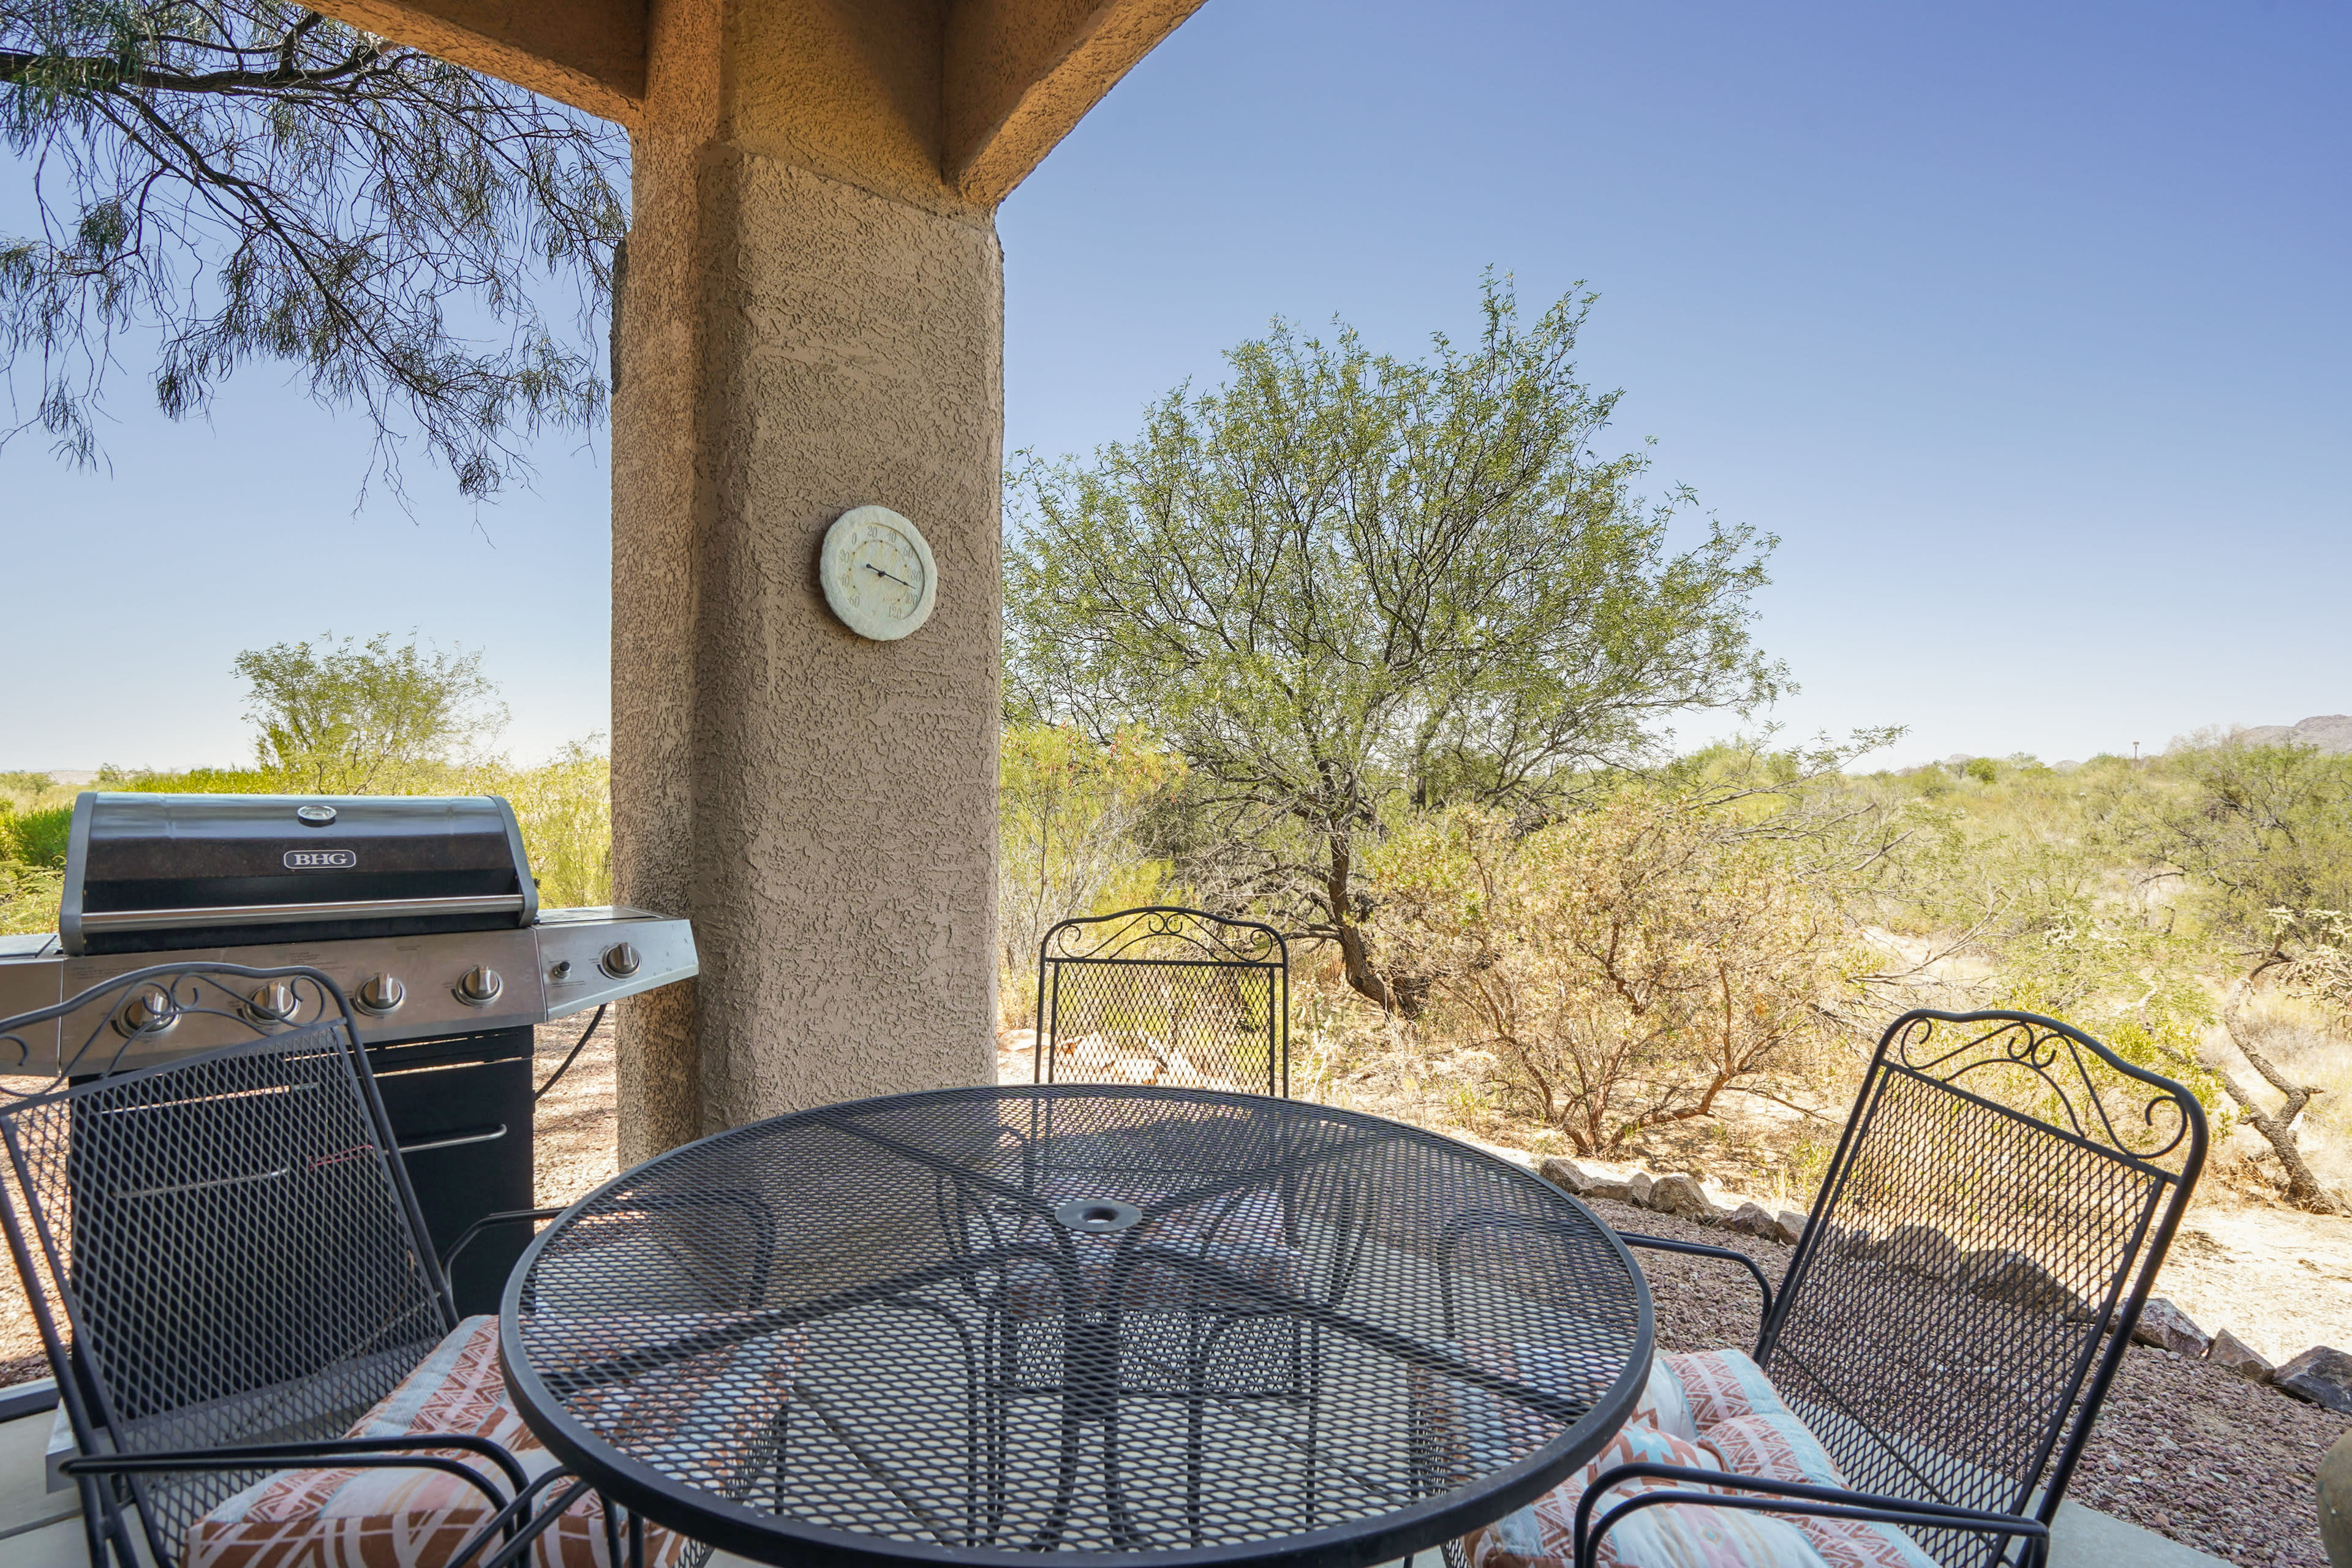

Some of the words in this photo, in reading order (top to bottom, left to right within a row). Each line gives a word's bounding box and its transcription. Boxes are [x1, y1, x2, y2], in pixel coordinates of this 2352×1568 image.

[867, 525, 877, 538] 20
[852, 533, 857, 545] 0
[910, 568, 921, 582] 80
[906, 592, 918, 606] 100
[294, 853, 347, 865] BHG
